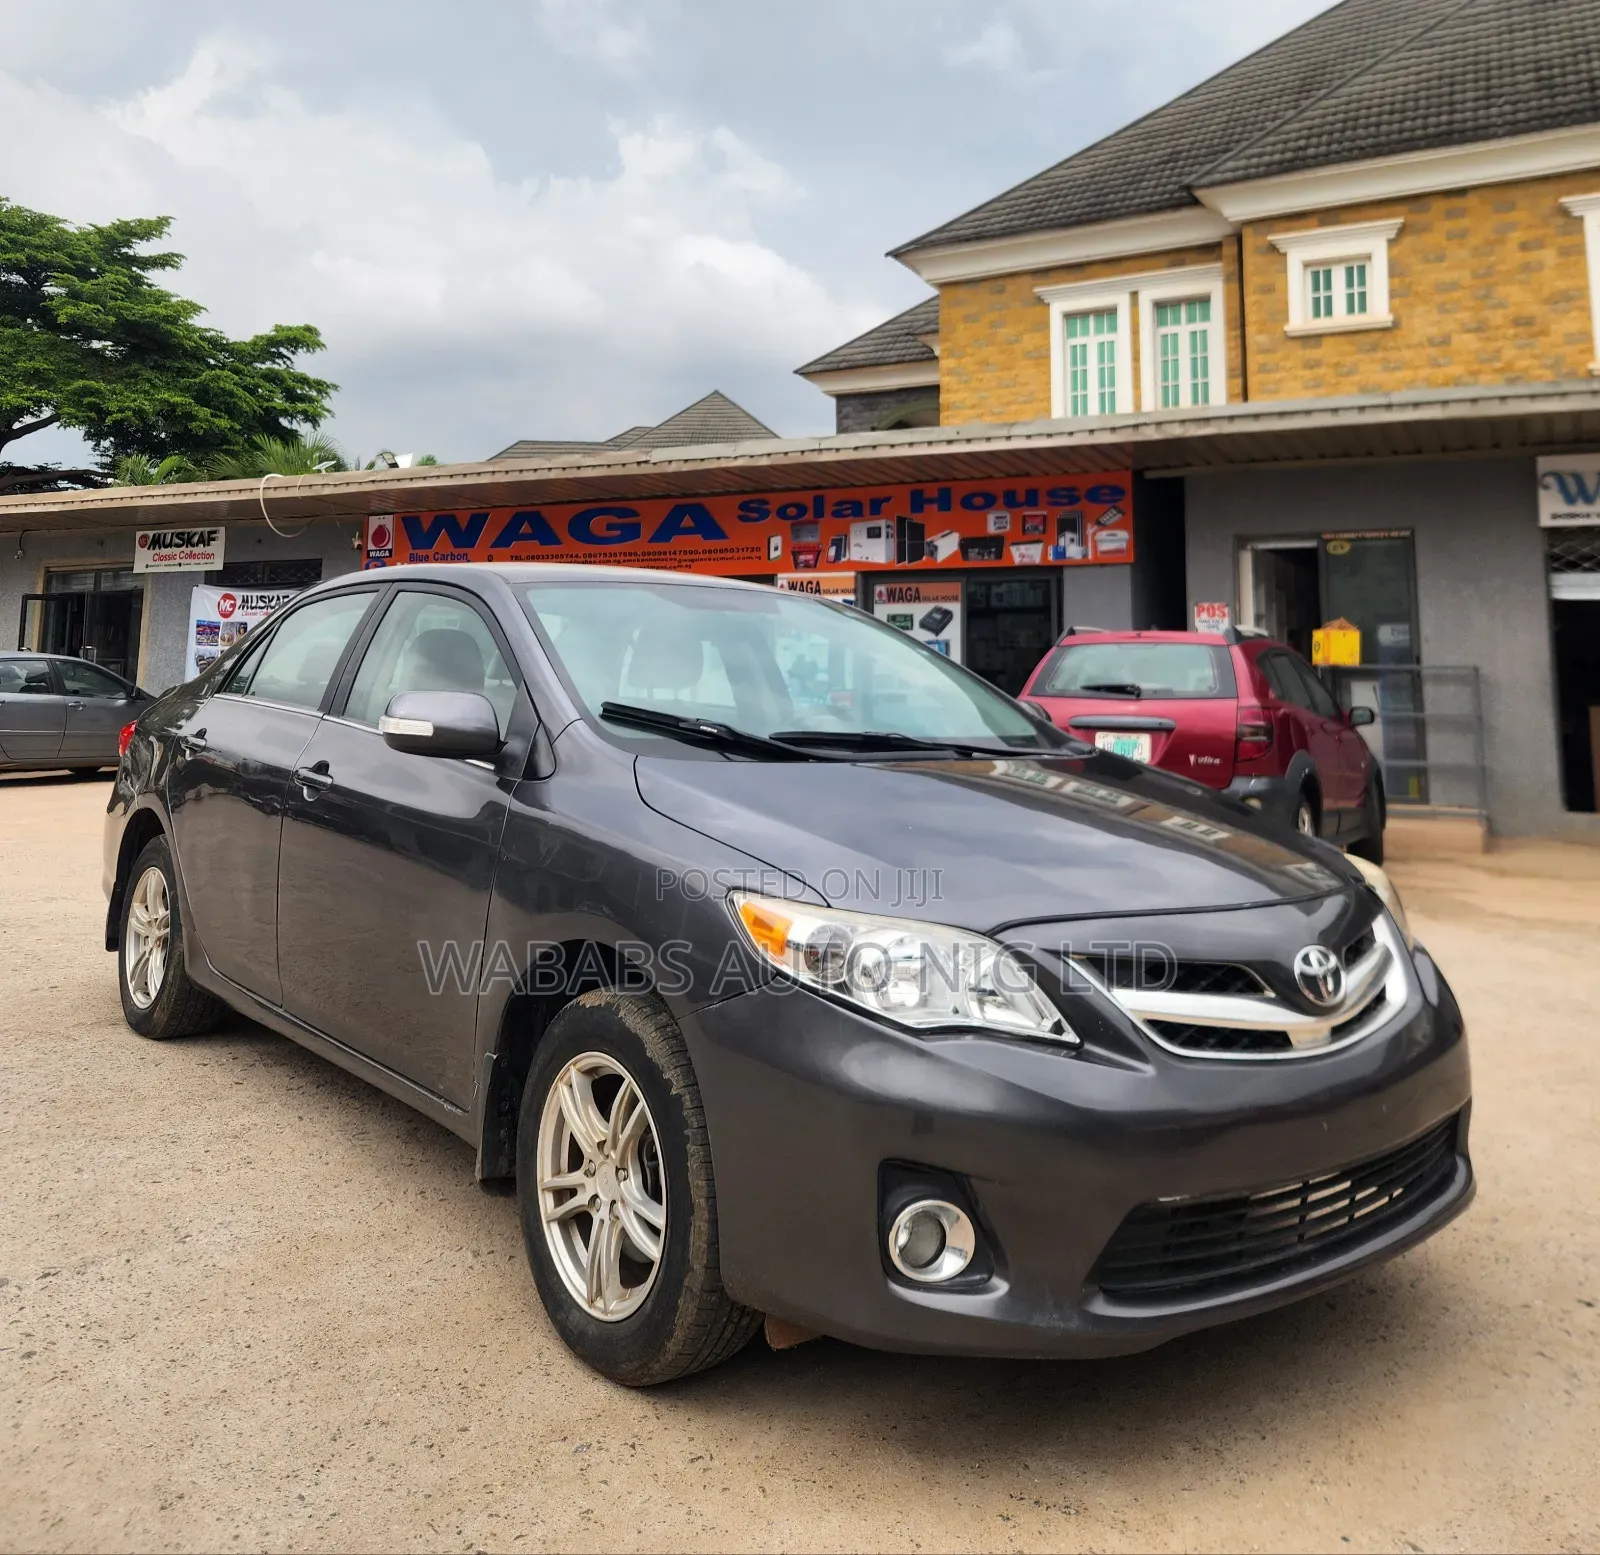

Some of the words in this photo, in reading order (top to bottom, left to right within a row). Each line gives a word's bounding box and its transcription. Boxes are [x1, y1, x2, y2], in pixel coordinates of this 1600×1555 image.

[401, 503, 729, 550] WAGA
[737, 495, 893, 523] Solar
[910, 484, 1126, 514] House
[147, 530, 219, 550] MUSKAF
[152, 551, 177, 562] Classic
[179, 550, 215, 560] Collection
[369, 550, 390, 558] WAGA
[409, 553, 430, 562] Blue
[433, 551, 468, 561] Carbon
[788, 580, 821, 595] WAGA
[886, 586, 921, 602] WAGA
[219, 599, 235, 612] MC
[1196, 603, 1227, 618] POS
